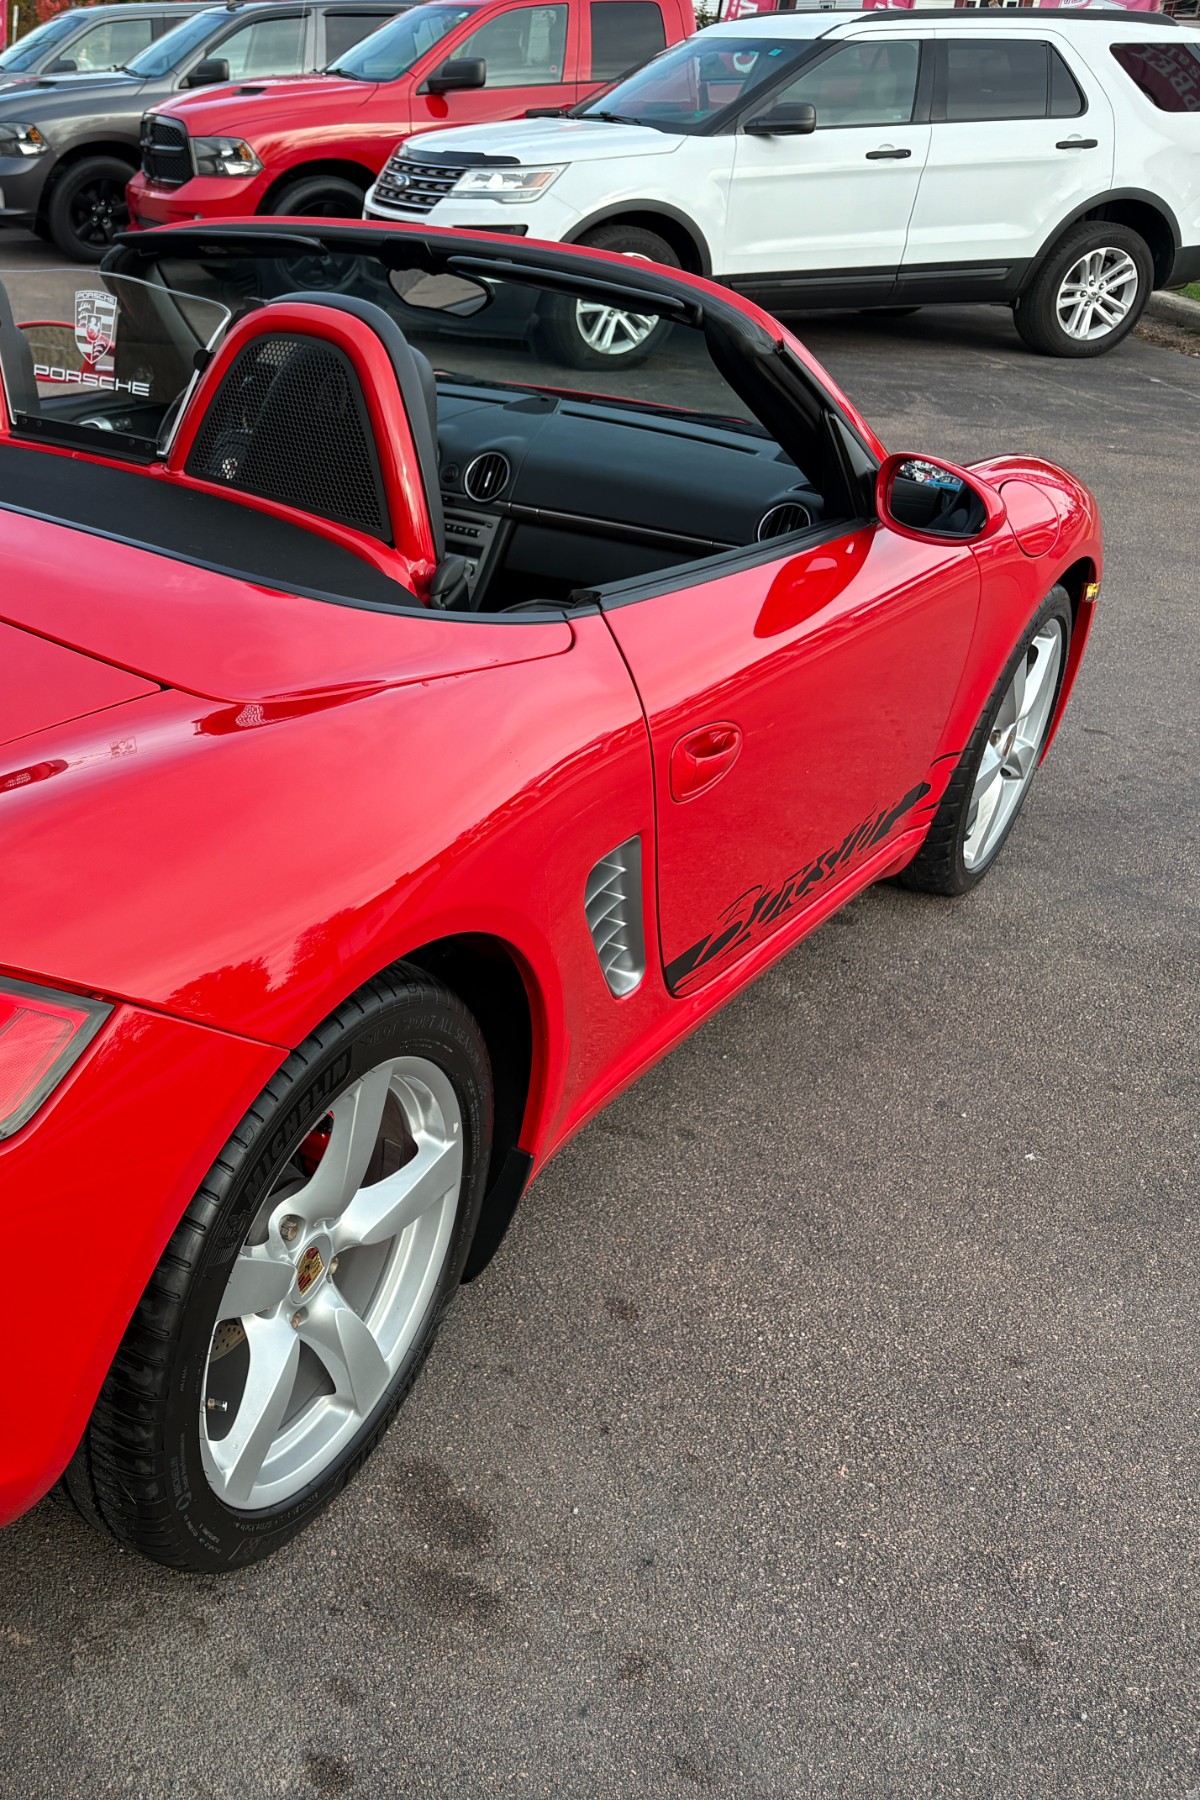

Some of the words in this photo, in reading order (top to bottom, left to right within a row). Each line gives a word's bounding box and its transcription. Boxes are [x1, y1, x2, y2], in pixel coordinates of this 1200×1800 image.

[77, 291, 115, 305] PORSCHE
[33, 363, 150, 397] PORSCHE
[244, 1053, 348, 1204] MICHELIN
